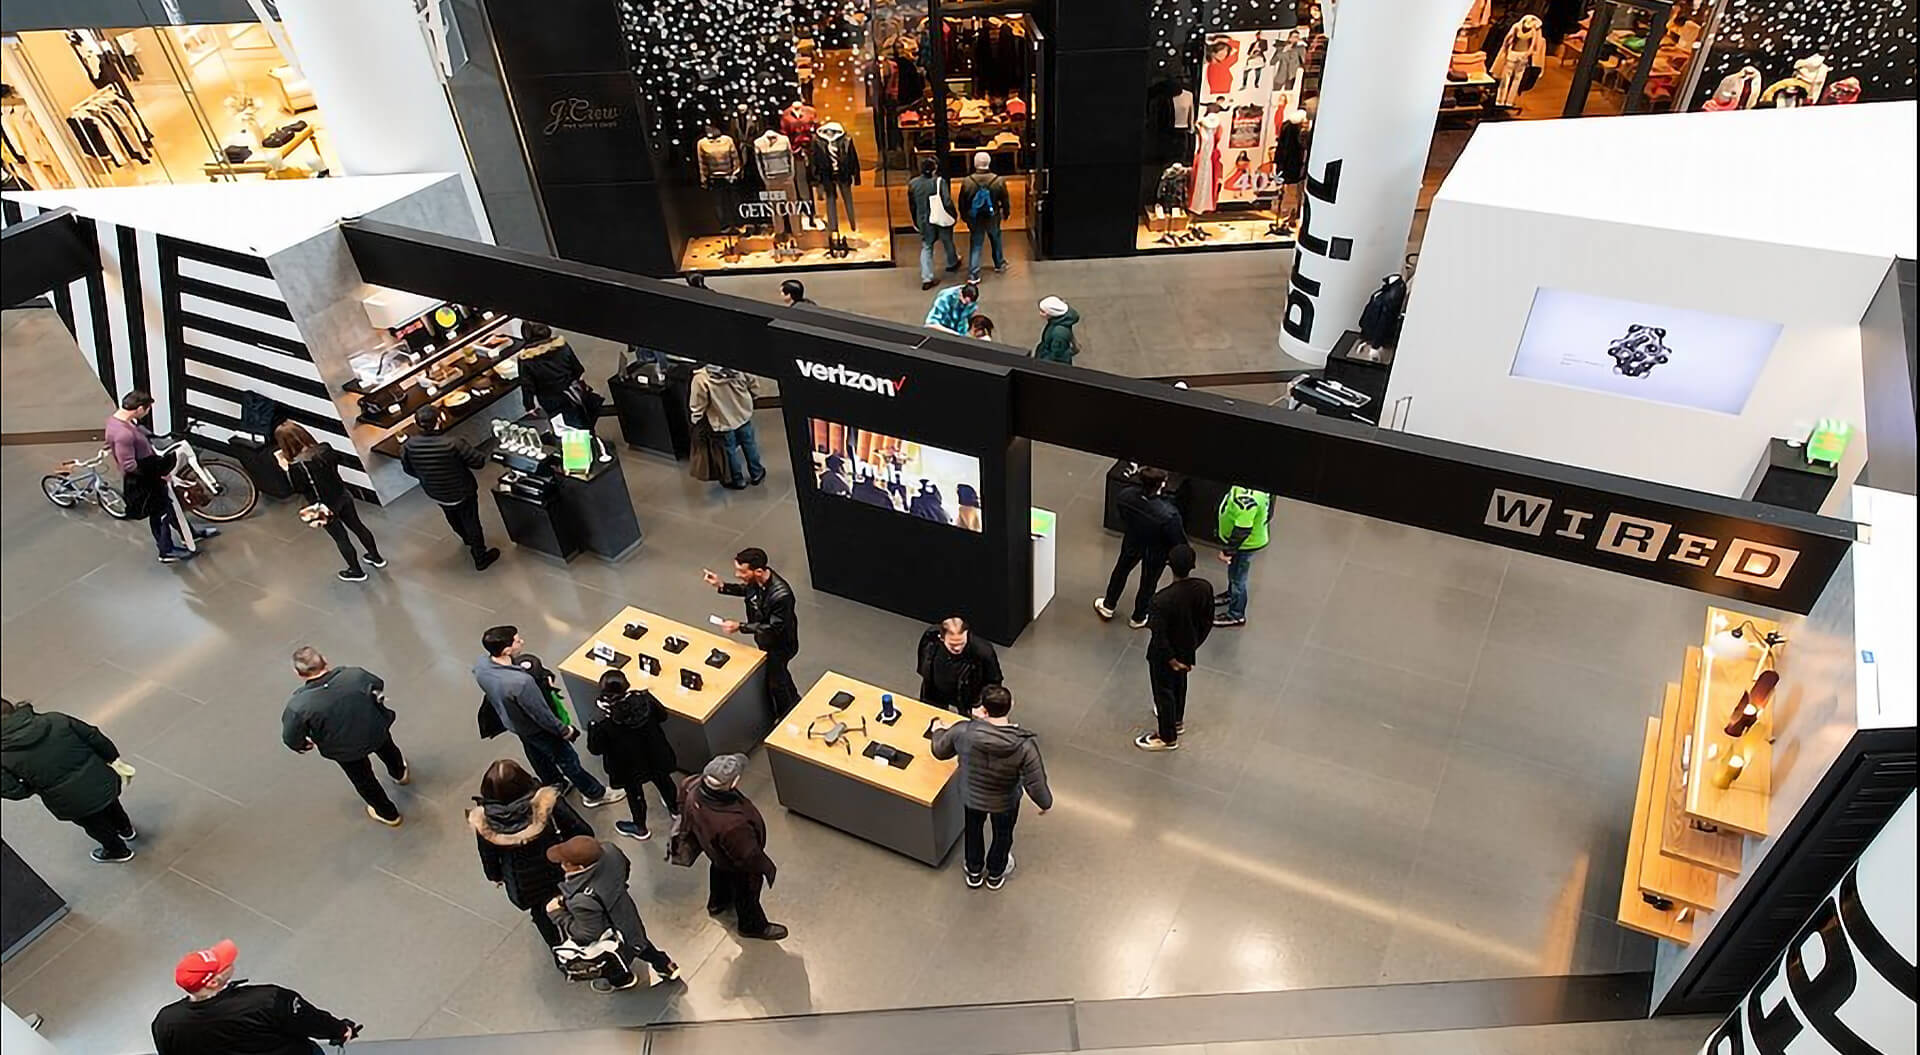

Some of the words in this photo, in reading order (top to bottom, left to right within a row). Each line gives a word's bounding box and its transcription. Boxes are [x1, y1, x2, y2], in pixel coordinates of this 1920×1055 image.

[738, 202, 775, 218] GETS
[796, 358, 896, 397] verizon
[1484, 488, 1800, 590] WIRED
